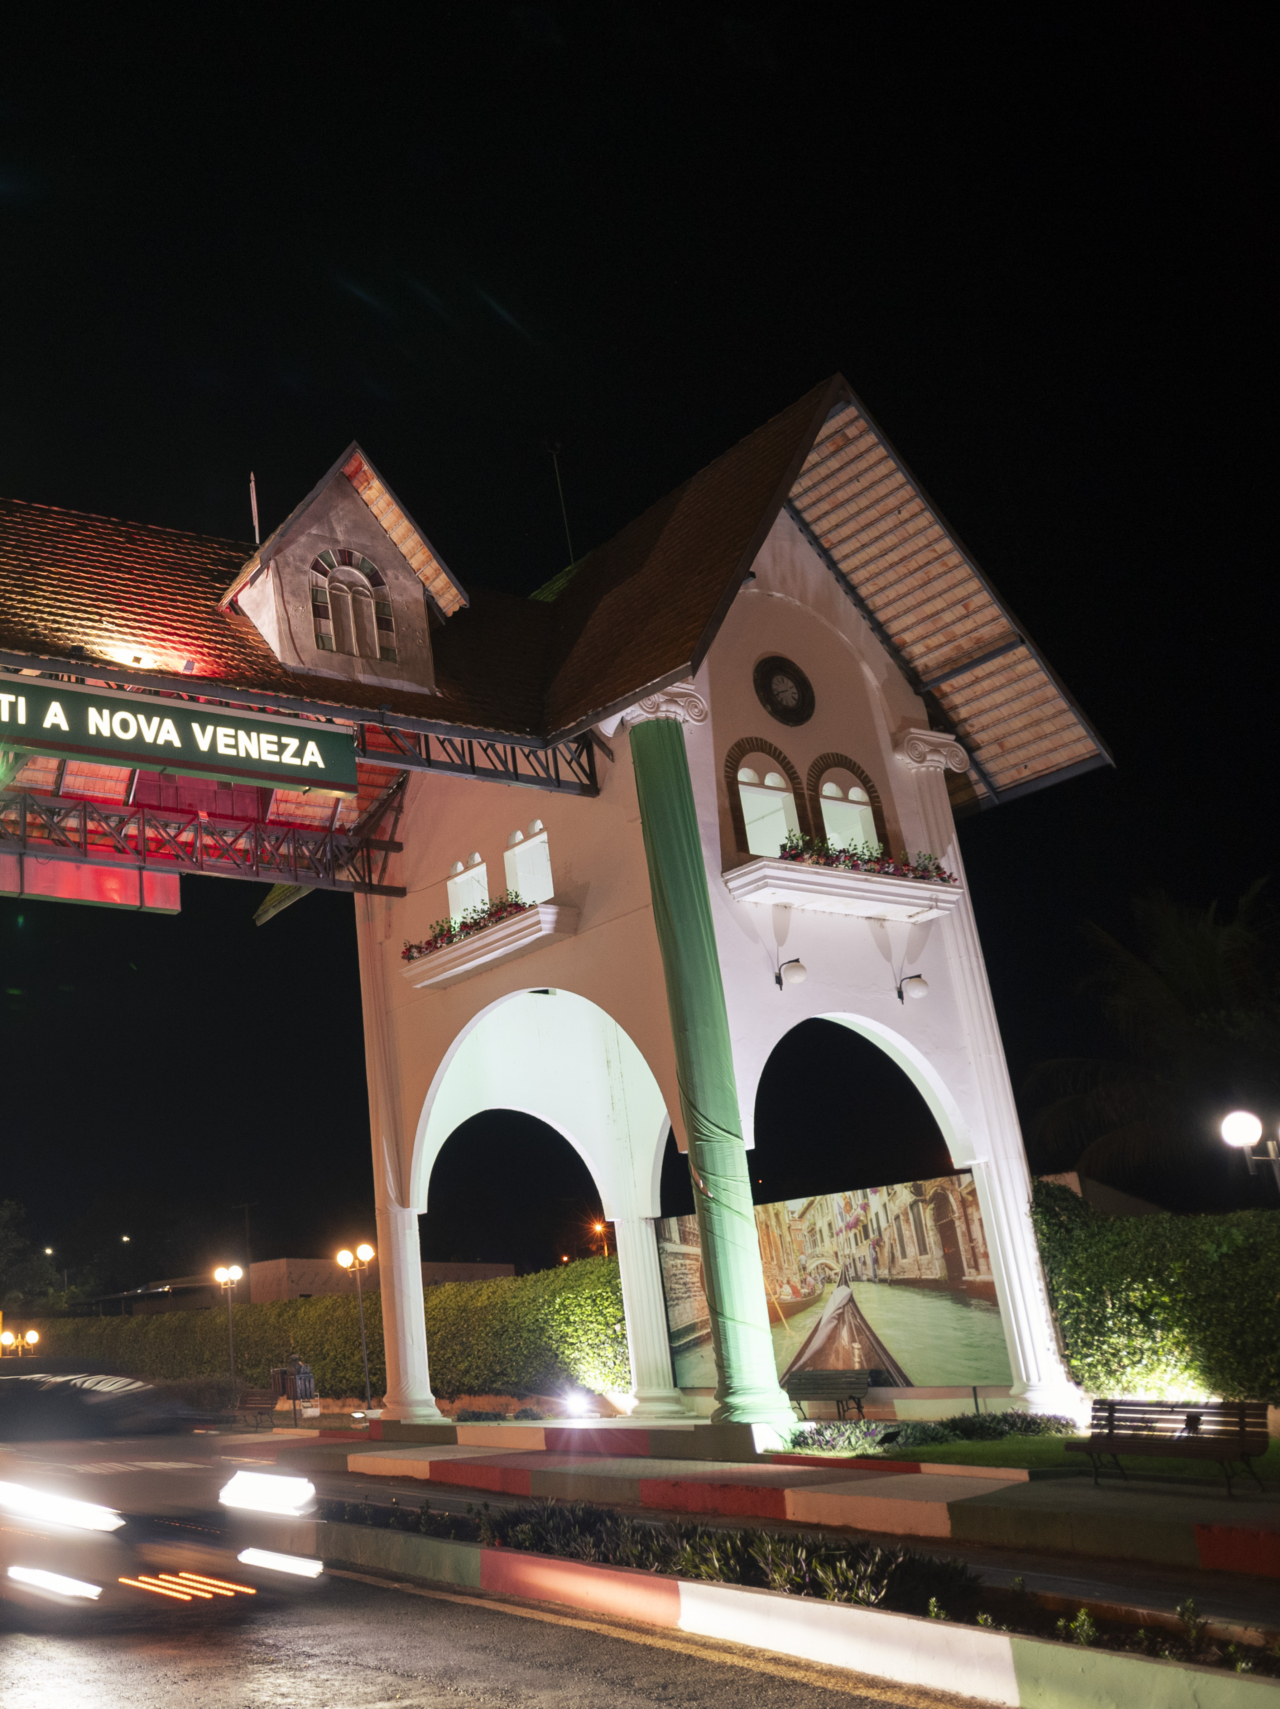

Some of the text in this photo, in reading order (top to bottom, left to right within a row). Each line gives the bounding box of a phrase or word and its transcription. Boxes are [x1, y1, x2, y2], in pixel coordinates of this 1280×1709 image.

[42, 701, 70, 732] A
[87, 706, 182, 748] NOVA
[191, 722, 326, 769] VENEZA
